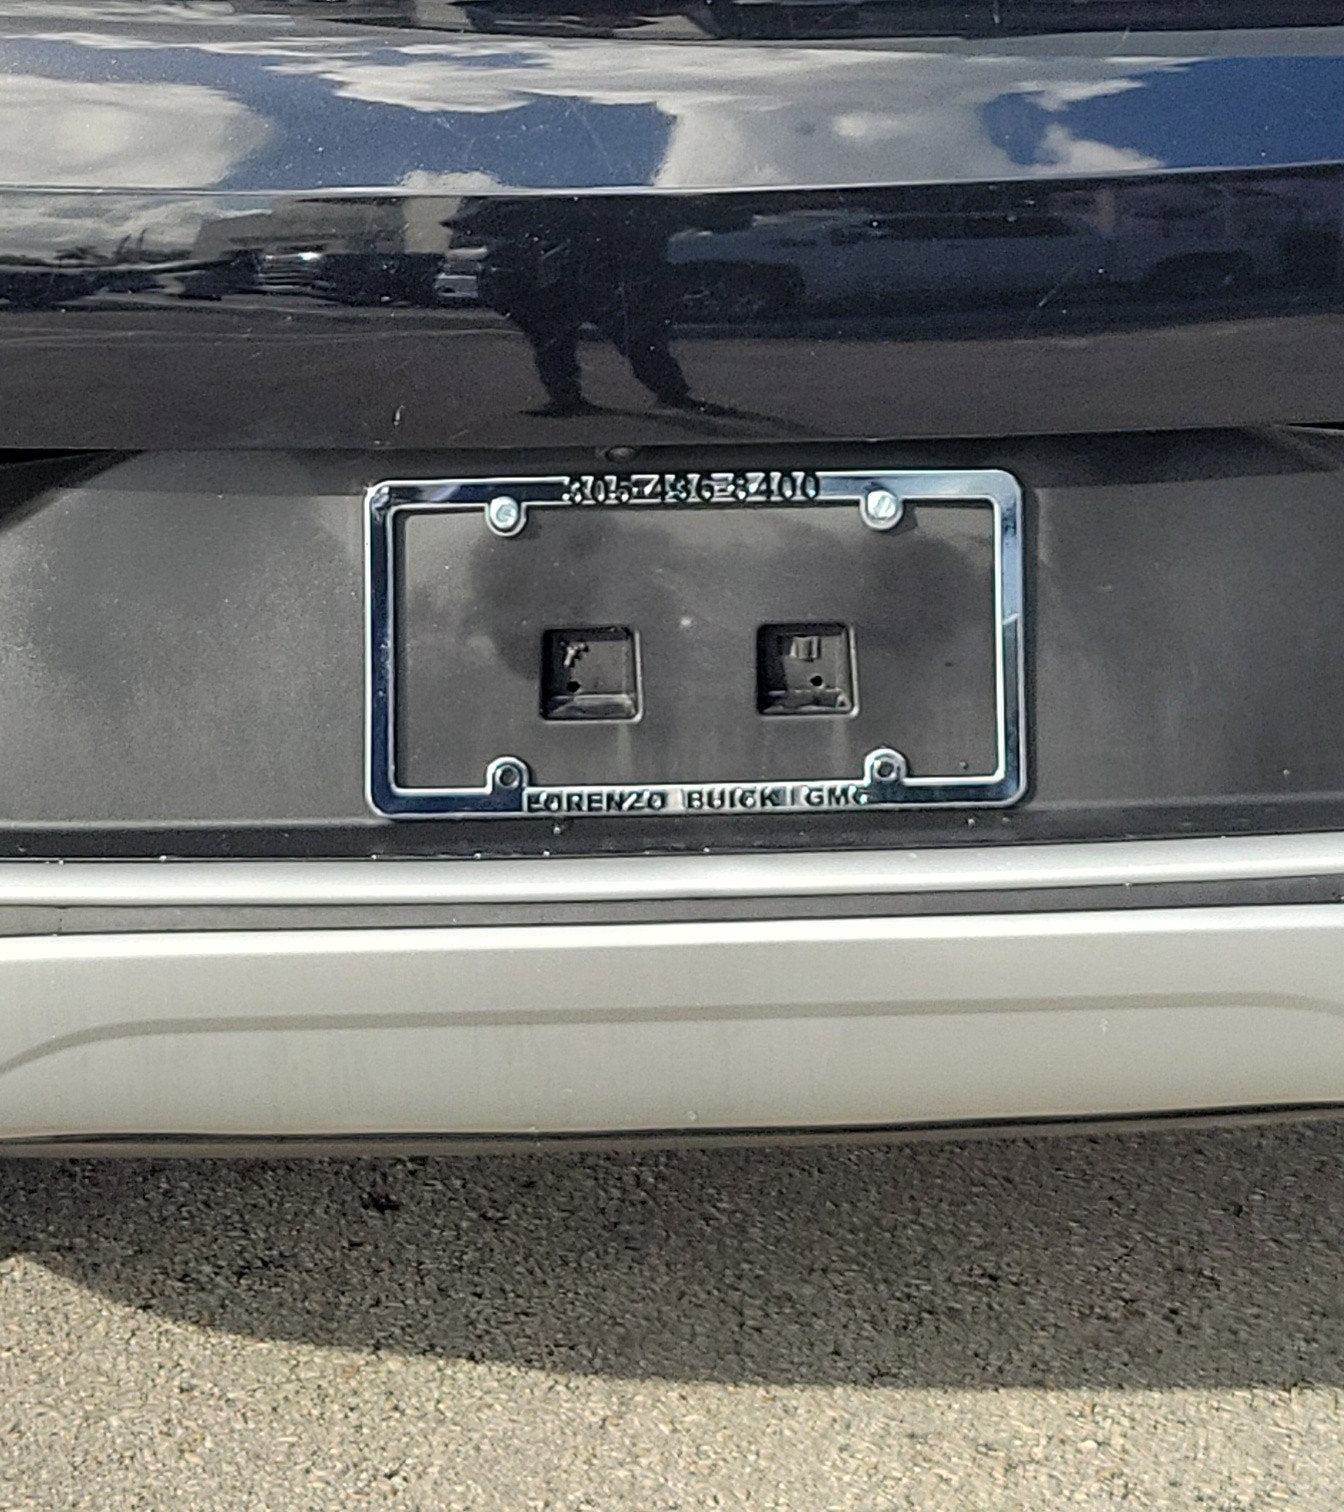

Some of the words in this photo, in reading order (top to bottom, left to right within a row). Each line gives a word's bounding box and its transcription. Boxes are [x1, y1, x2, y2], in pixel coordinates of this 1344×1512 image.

[525, 790, 668, 813] LORENZO
[687, 785, 781, 809] BUICK
[802, 784, 870, 806] GMC
